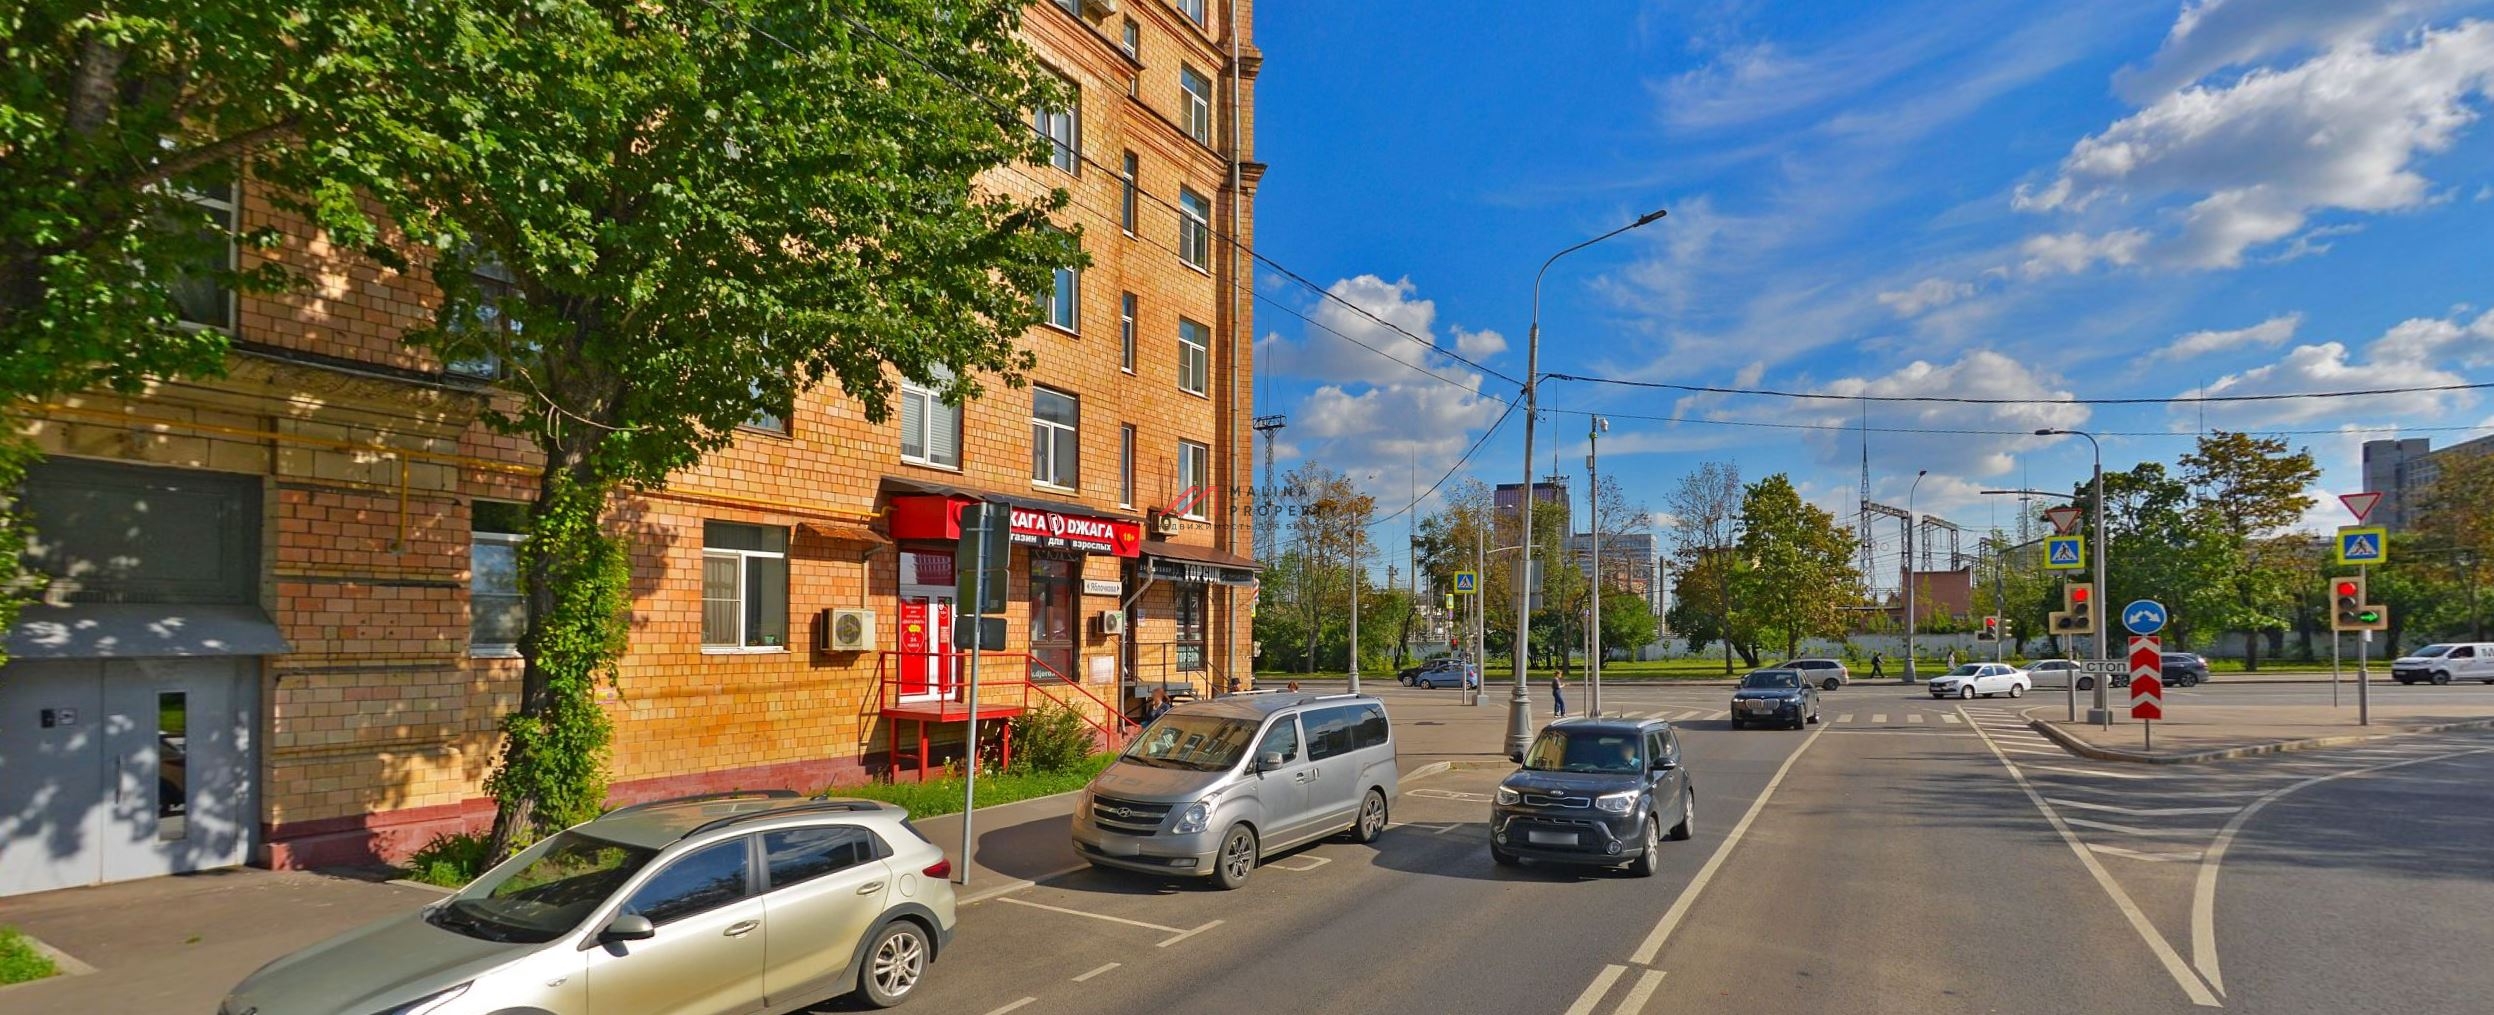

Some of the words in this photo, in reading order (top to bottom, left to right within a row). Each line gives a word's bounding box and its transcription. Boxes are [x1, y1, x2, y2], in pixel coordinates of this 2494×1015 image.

[1010, 533, 1037, 543] газин
[1047, 537, 1065, 547] для
[1072, 539, 1112, 551] взрослых
[1123, 532, 1135, 542] 18+
[1184, 564, 1221, 582] TOPGUN
[2087, 663, 2127, 672] СТОП
